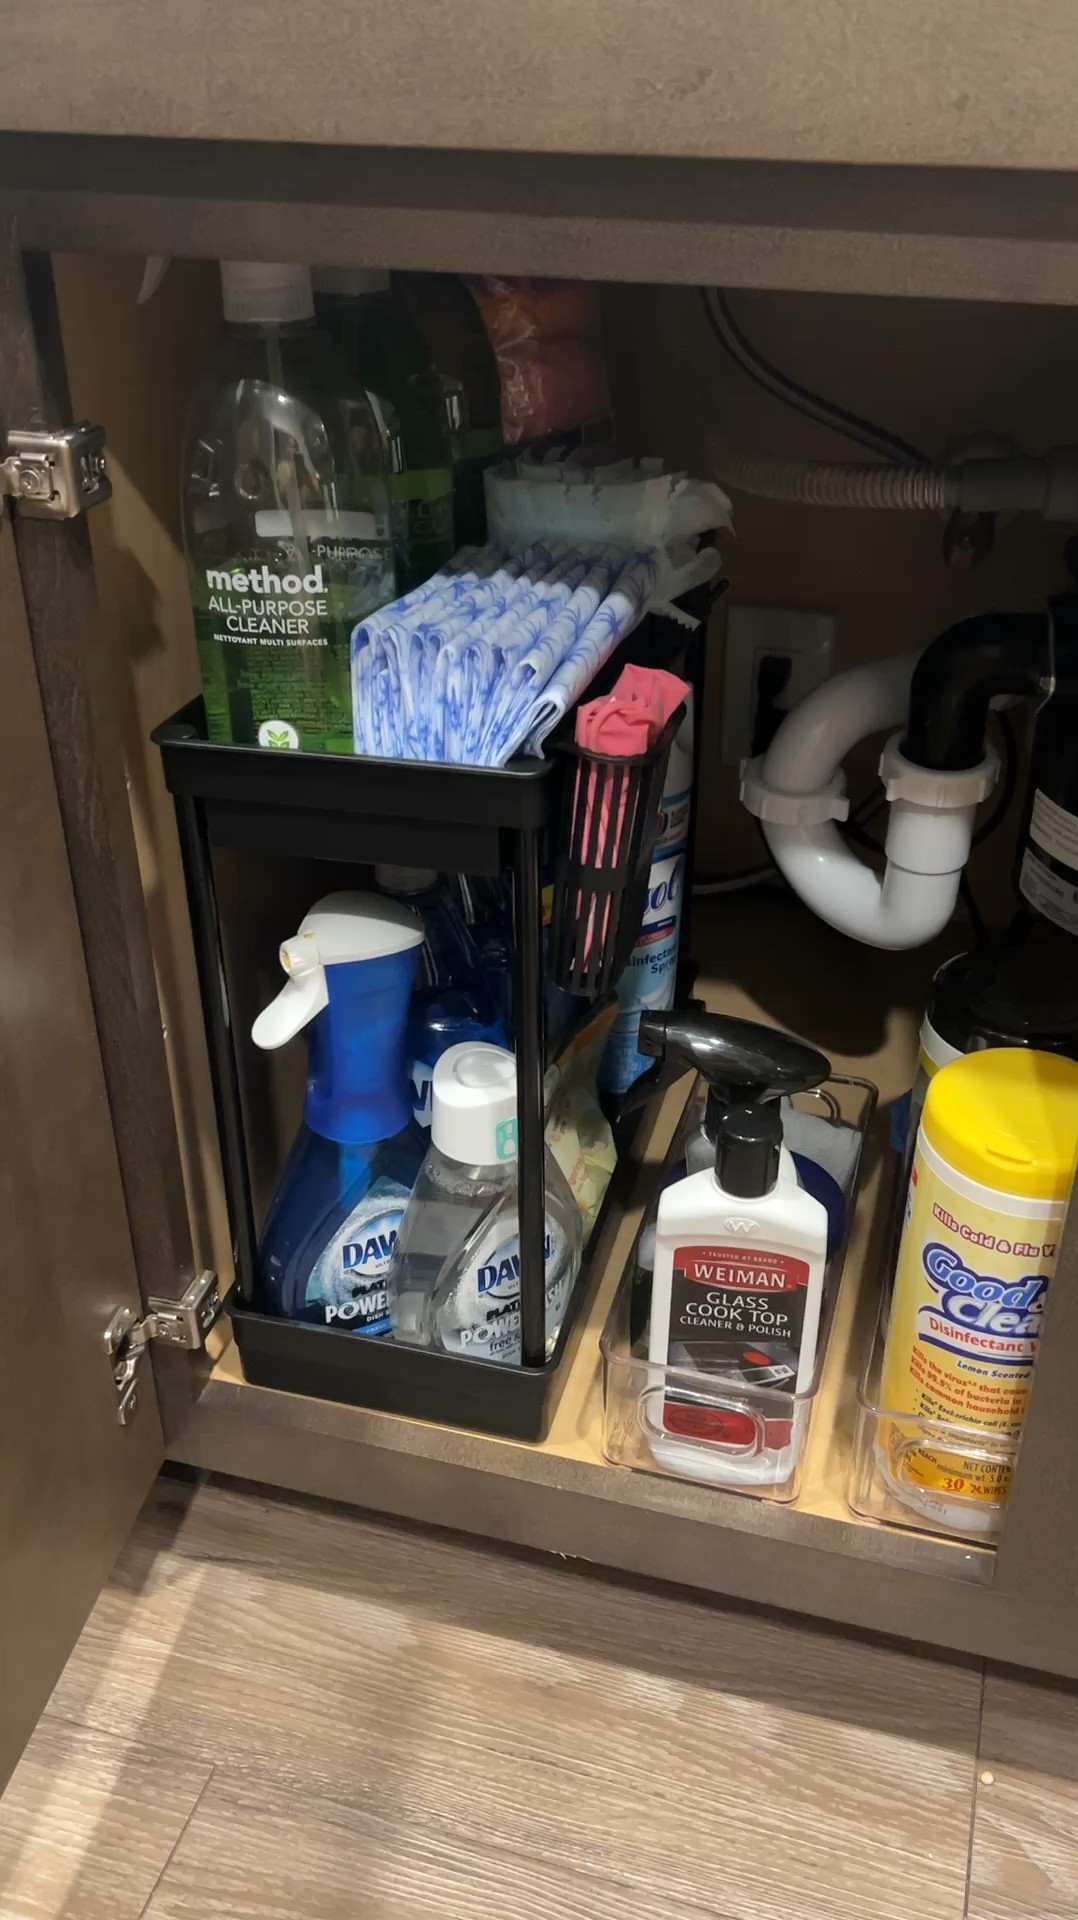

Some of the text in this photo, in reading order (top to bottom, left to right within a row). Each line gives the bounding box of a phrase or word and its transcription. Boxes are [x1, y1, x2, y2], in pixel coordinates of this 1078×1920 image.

[208, 596, 328, 616] ALL-PURPOSE
[226, 616, 309, 634] CLEANER
[213, 634, 328, 647] NETTOYANT MULTI SURFACES
[933, 1202, 960, 1233] Kills
[960, 1225, 995, 1250] Cold
[996, 1240, 1011, 1255] &
[1013, 1243, 1040, 1258] Flu
[694, 1263, 786, 1289] WEIMAN
[926, 1248, 1044, 1309] Good
[706, 1292, 769, 1310] GLASS
[685, 1302, 788, 1326] COOK TOP
[948, 1295, 1041, 1335] Clea
[680, 1315, 791, 1338] CLEANER & POLISH
[929, 1317, 1023, 1353] Disinfectant
[489, 1337, 512, 1352] free
[910, 1355, 926, 1374] Kills
[927, 1370, 952, 1391] 99.9%
[954, 1387, 965, 1396] of
[966, 1391, 1010, 1405] bacteria
[912, 1345, 927, 1364] Kills
[929, 1361, 942, 1375] the
[979, 1384, 1001, 1394] that
[957, 1361, 1031, 1379] Lemon Scented
[909, 1365, 1020, 1415] Kills common household
[963, 1461, 1011, 1473] NET CONTEN
[942, 1478, 965, 1492] 30
